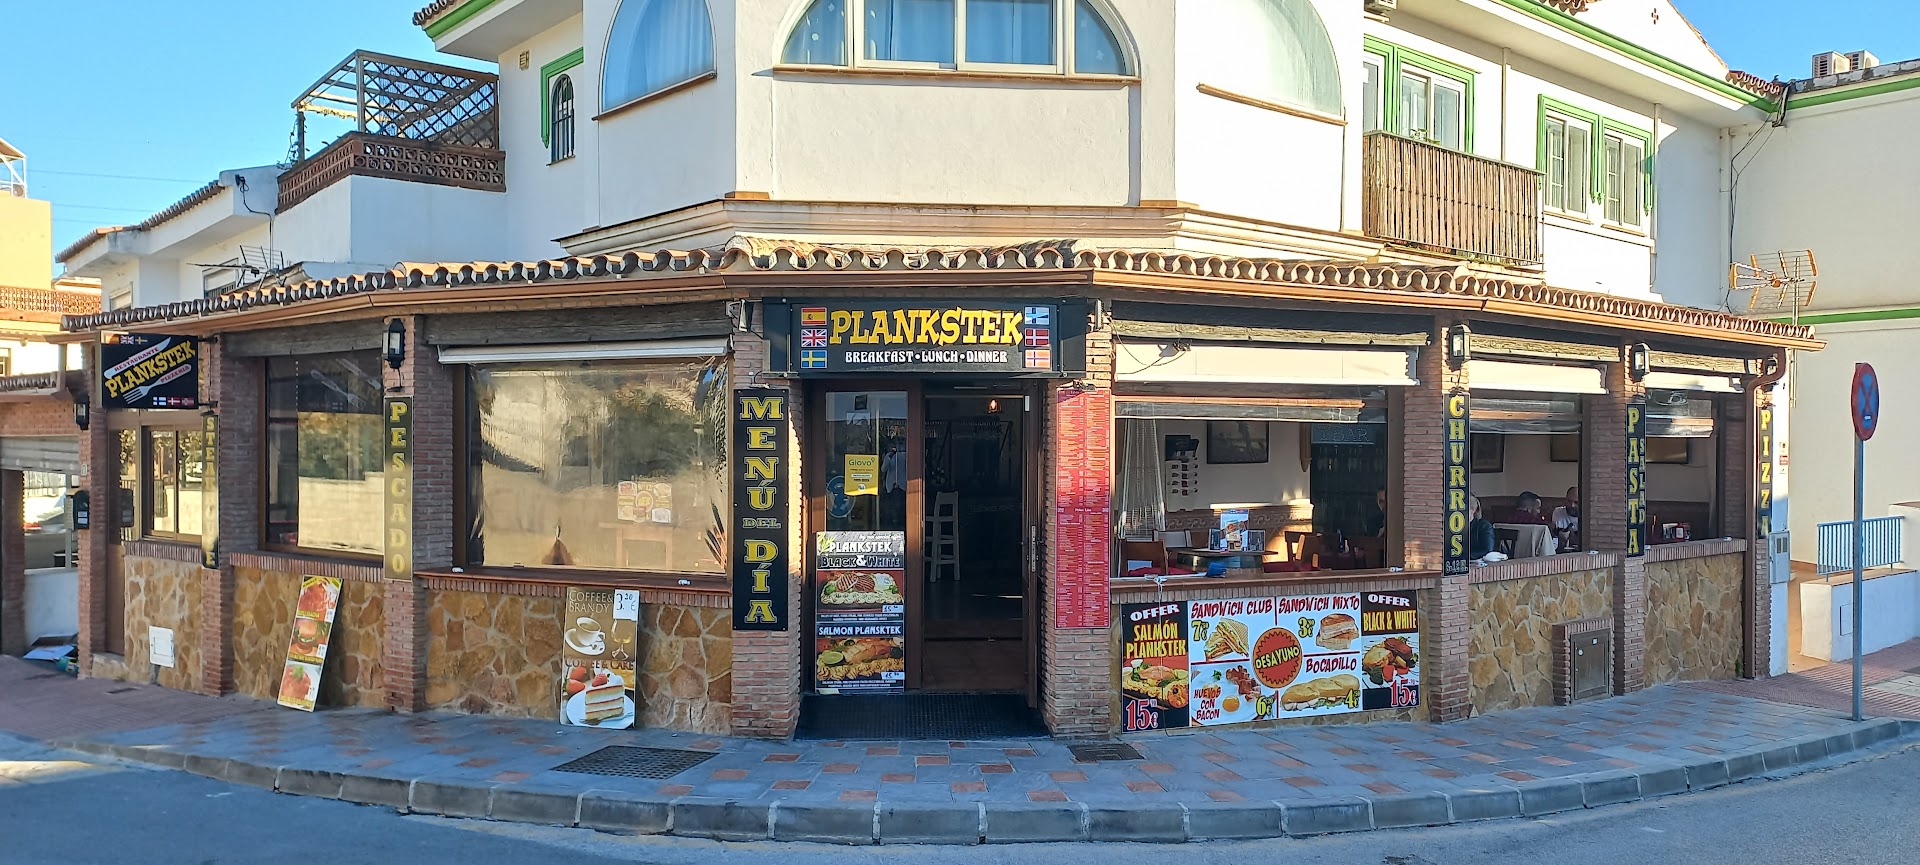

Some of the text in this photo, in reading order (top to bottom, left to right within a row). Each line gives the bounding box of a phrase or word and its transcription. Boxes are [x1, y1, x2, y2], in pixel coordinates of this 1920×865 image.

[829, 306, 1024, 346] PLANKSTEK
[114, 347, 160, 372] RESTAURANTE
[845, 350, 1008, 363] BREAKFAST LUNCH DINNER
[105, 340, 196, 398] PLANKSTEK
[848, 458, 872, 466] Glovo
[1448, 395, 1466, 557] CHURROS
[1628, 407, 1640, 555] PASTA
[1760, 410, 1771, 538] PIZZA
[389, 402, 407, 574] PESCADO
[740, 397, 784, 623] MENÚ DEL DÍA
[829, 542, 892, 552] PLANKSTEK
[569, 601, 610, 613] BRANDY
[1246, 599, 1273, 614] CLUB
[1368, 593, 1411, 607] OFFER
[1130, 604, 1180, 621] OFFER
[1363, 609, 1417, 632] BLACK & WHITE
[818, 626, 853, 635] SALMON
[1134, 620, 1178, 641] SALMÓN
[1126, 640, 1187, 659] PLANKSTEK
[1256, 646, 1300, 669] DESAYUNO
[565, 658, 600, 668] COFEE
[611, 660, 634, 670] CAKE
[1193, 687, 1222, 699] HUEVOS
[1201, 698, 1215, 710] CON
[1196, 708, 1220, 720] BACON
